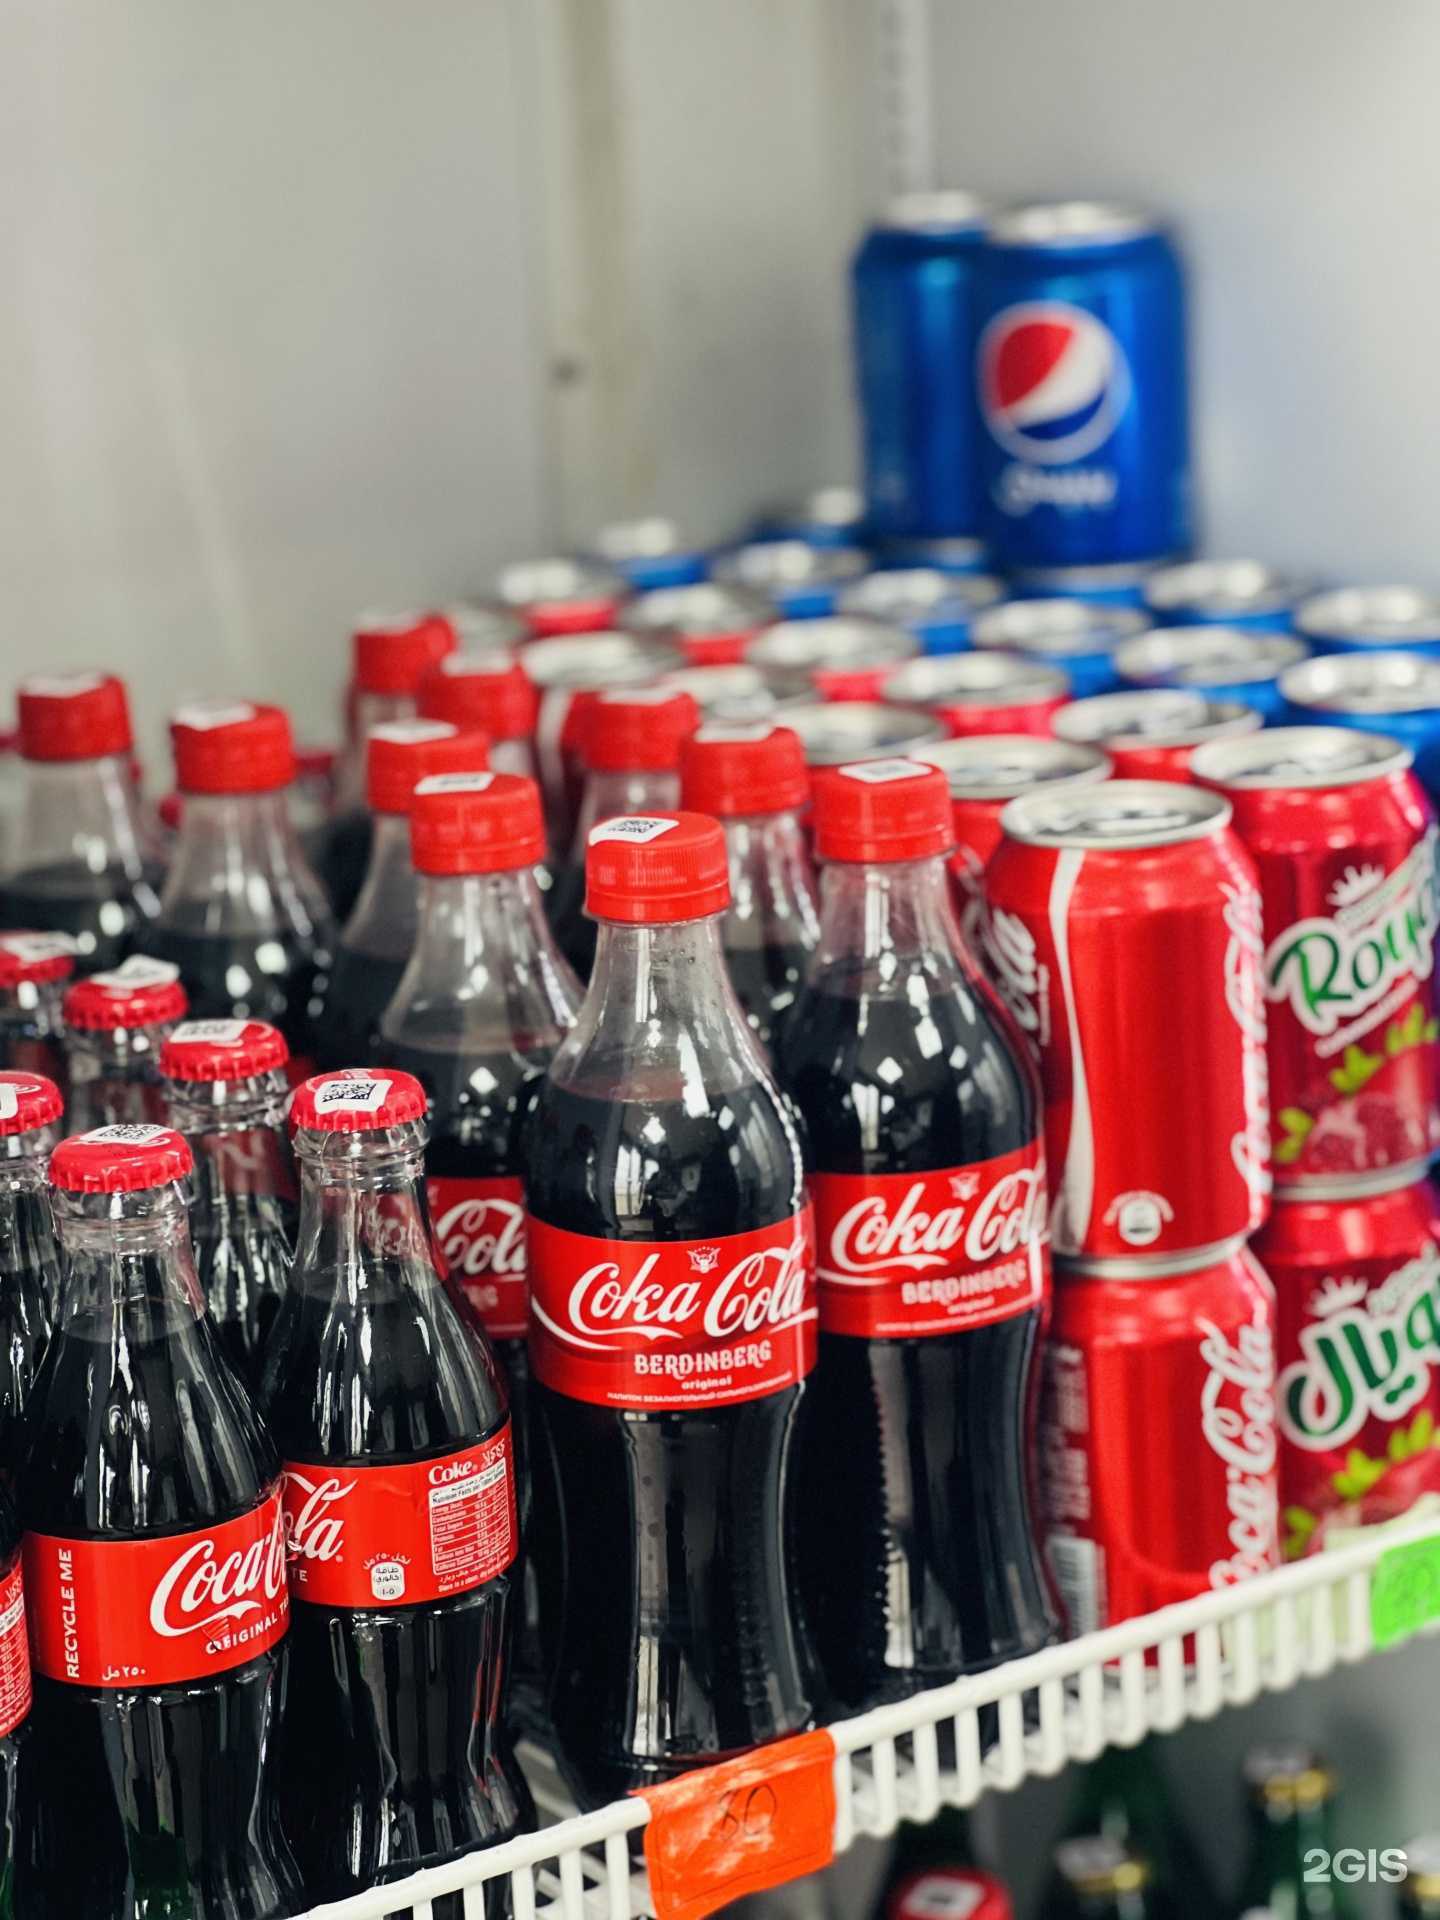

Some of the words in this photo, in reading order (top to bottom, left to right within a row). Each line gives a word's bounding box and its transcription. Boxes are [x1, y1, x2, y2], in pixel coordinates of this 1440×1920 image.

[830, 1181, 966, 1273] Coka
[567, 1252, 702, 1341] Coka
[702, 1233, 808, 1338] Cola
[633, 1339, 773, 1381] BERDINBERG
[680, 1375, 733, 1391] original
[428, 1460, 474, 1486] Coke
[58, 1548, 73, 1582] ME
[60, 1585, 80, 1679] RECYCLE
